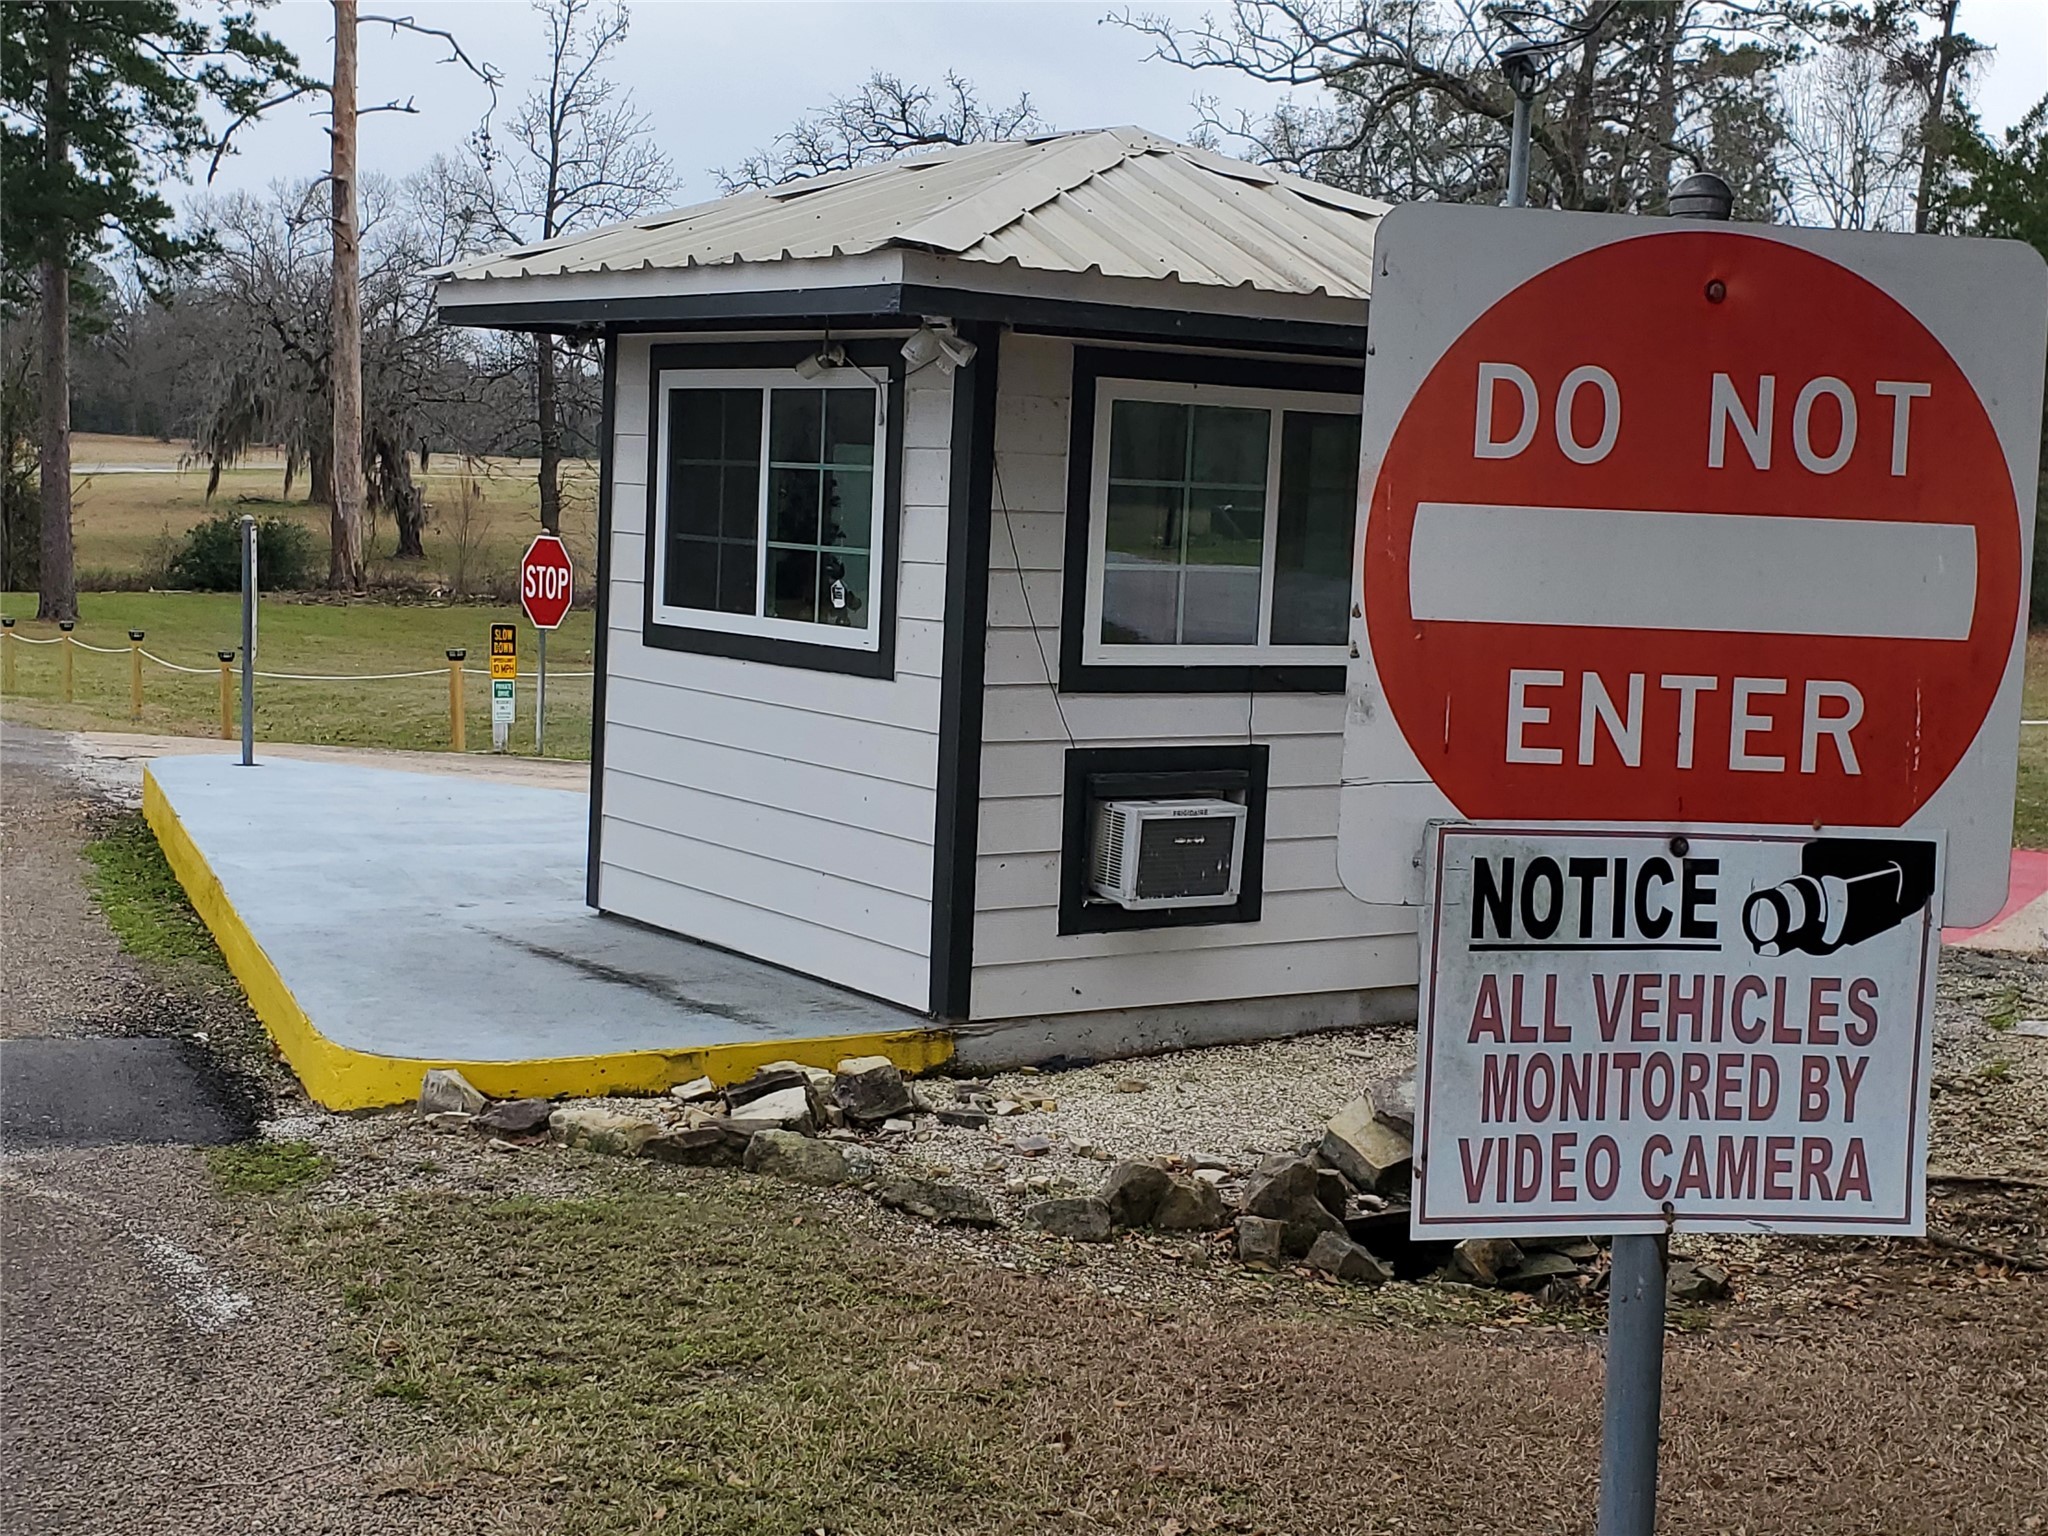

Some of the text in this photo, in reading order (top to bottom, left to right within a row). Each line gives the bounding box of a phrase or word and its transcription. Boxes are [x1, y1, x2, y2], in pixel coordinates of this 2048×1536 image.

[1474, 361, 1932, 478] DO NOT
[526, 564, 569, 599] STOP
[494, 629, 513, 640] SLOW
[494, 642, 513, 653] DOWN
[1505, 668, 1865, 776] ENTER
[1471, 856, 1721, 941] NOTICE
[1468, 972, 1880, 1047] ALL VEHICLES
[1481, 1051, 1870, 1123] MONITORED BY
[1458, 1134, 1872, 1203] VIDEO CAMERA
